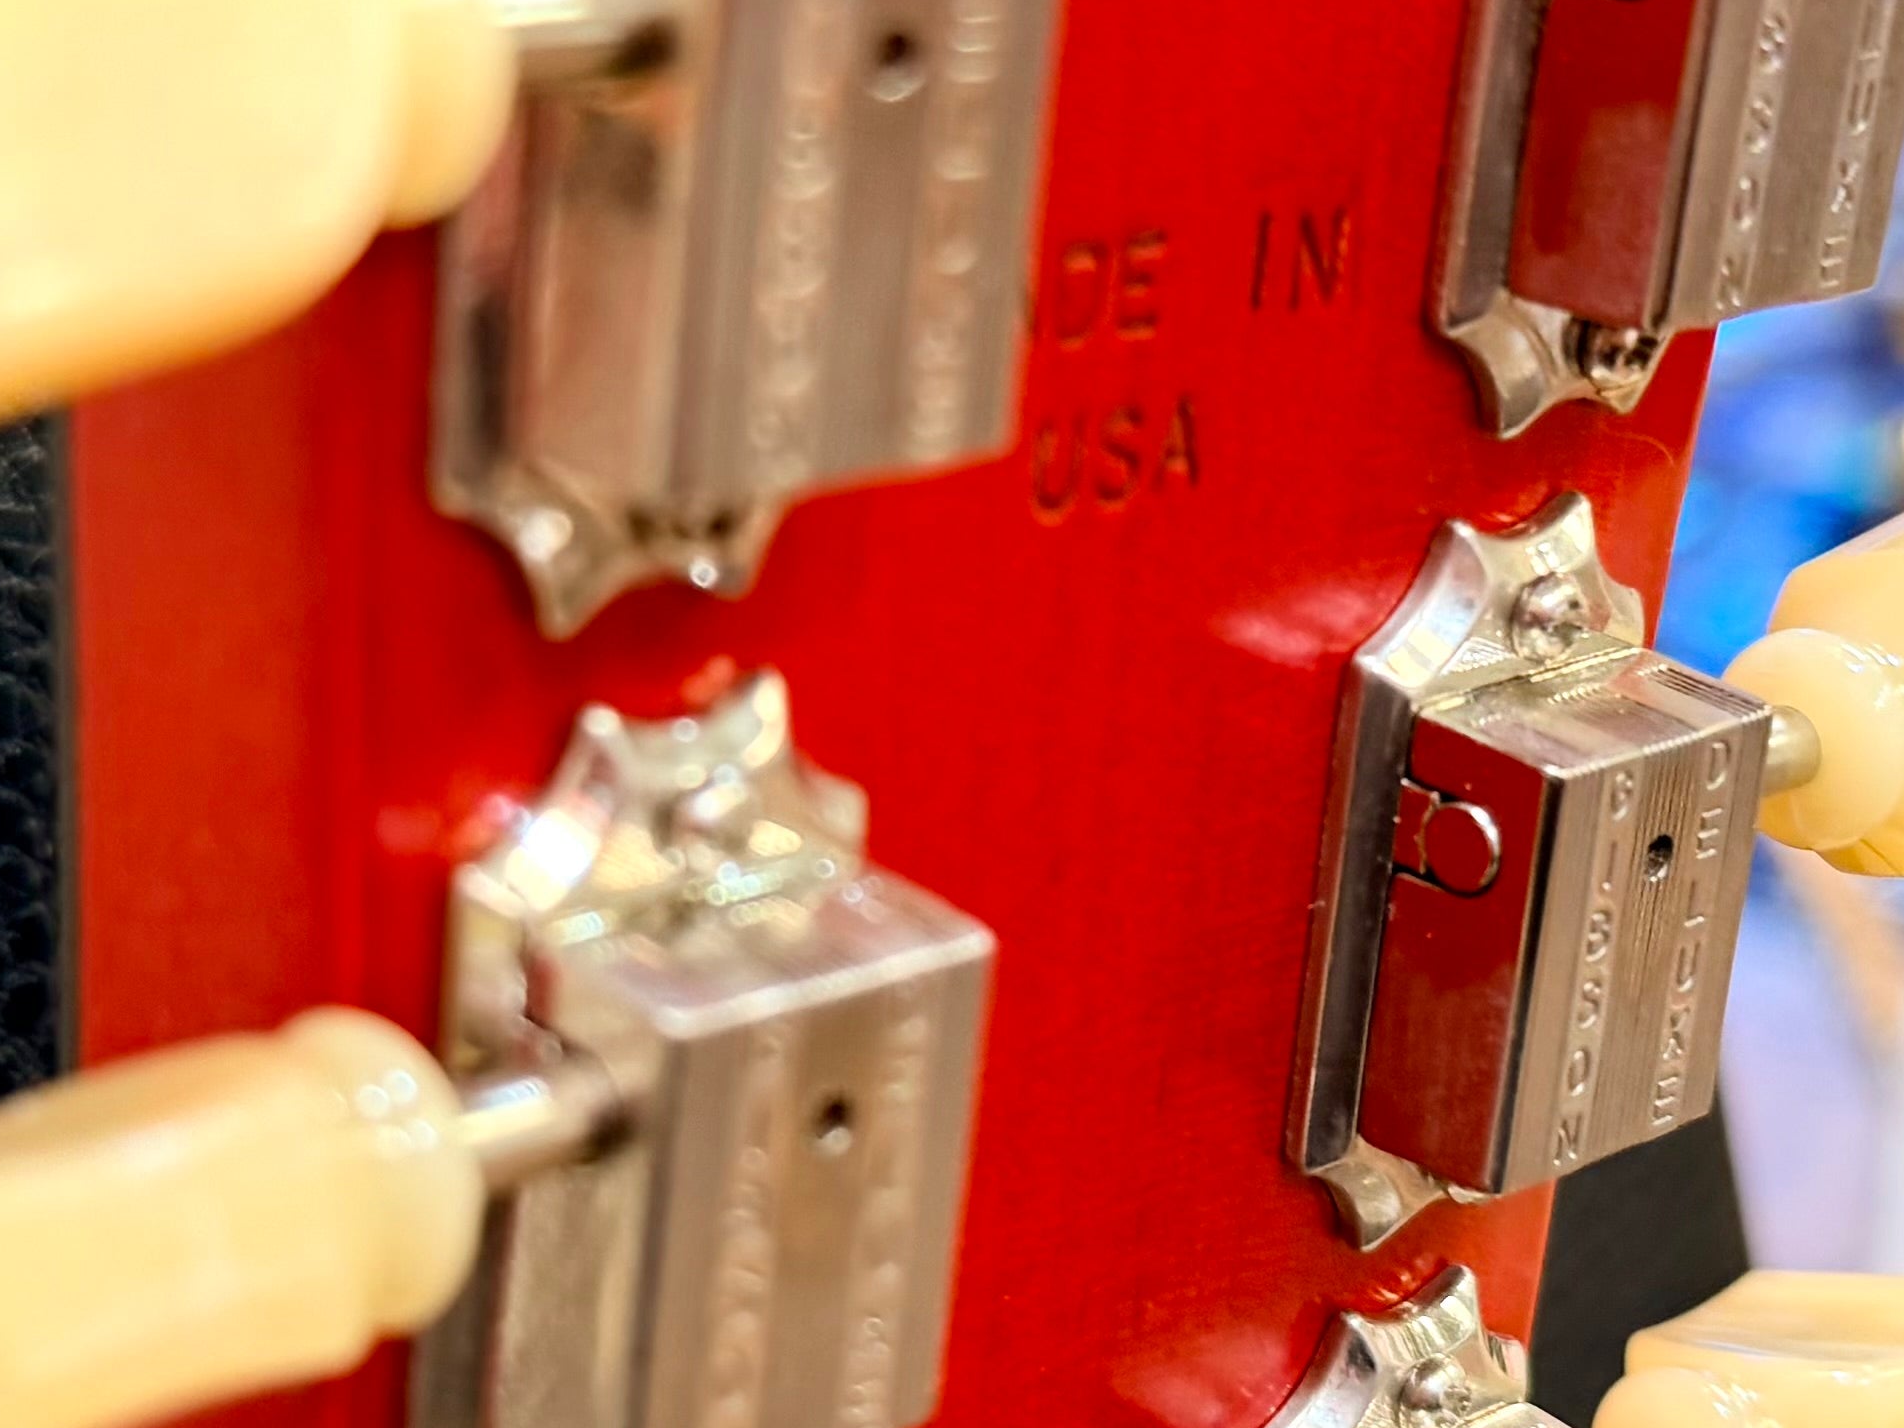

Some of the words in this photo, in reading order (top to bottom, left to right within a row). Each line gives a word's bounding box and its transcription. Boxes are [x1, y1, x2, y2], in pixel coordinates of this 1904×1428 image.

[1030, 228, 1169, 348] DE
[1246, 204, 1354, 312] IN
[1030, 390, 1200, 526] USA
[1553, 772, 1635, 1166] GIBSON
[1651, 740, 1730, 1126] DELUXE
